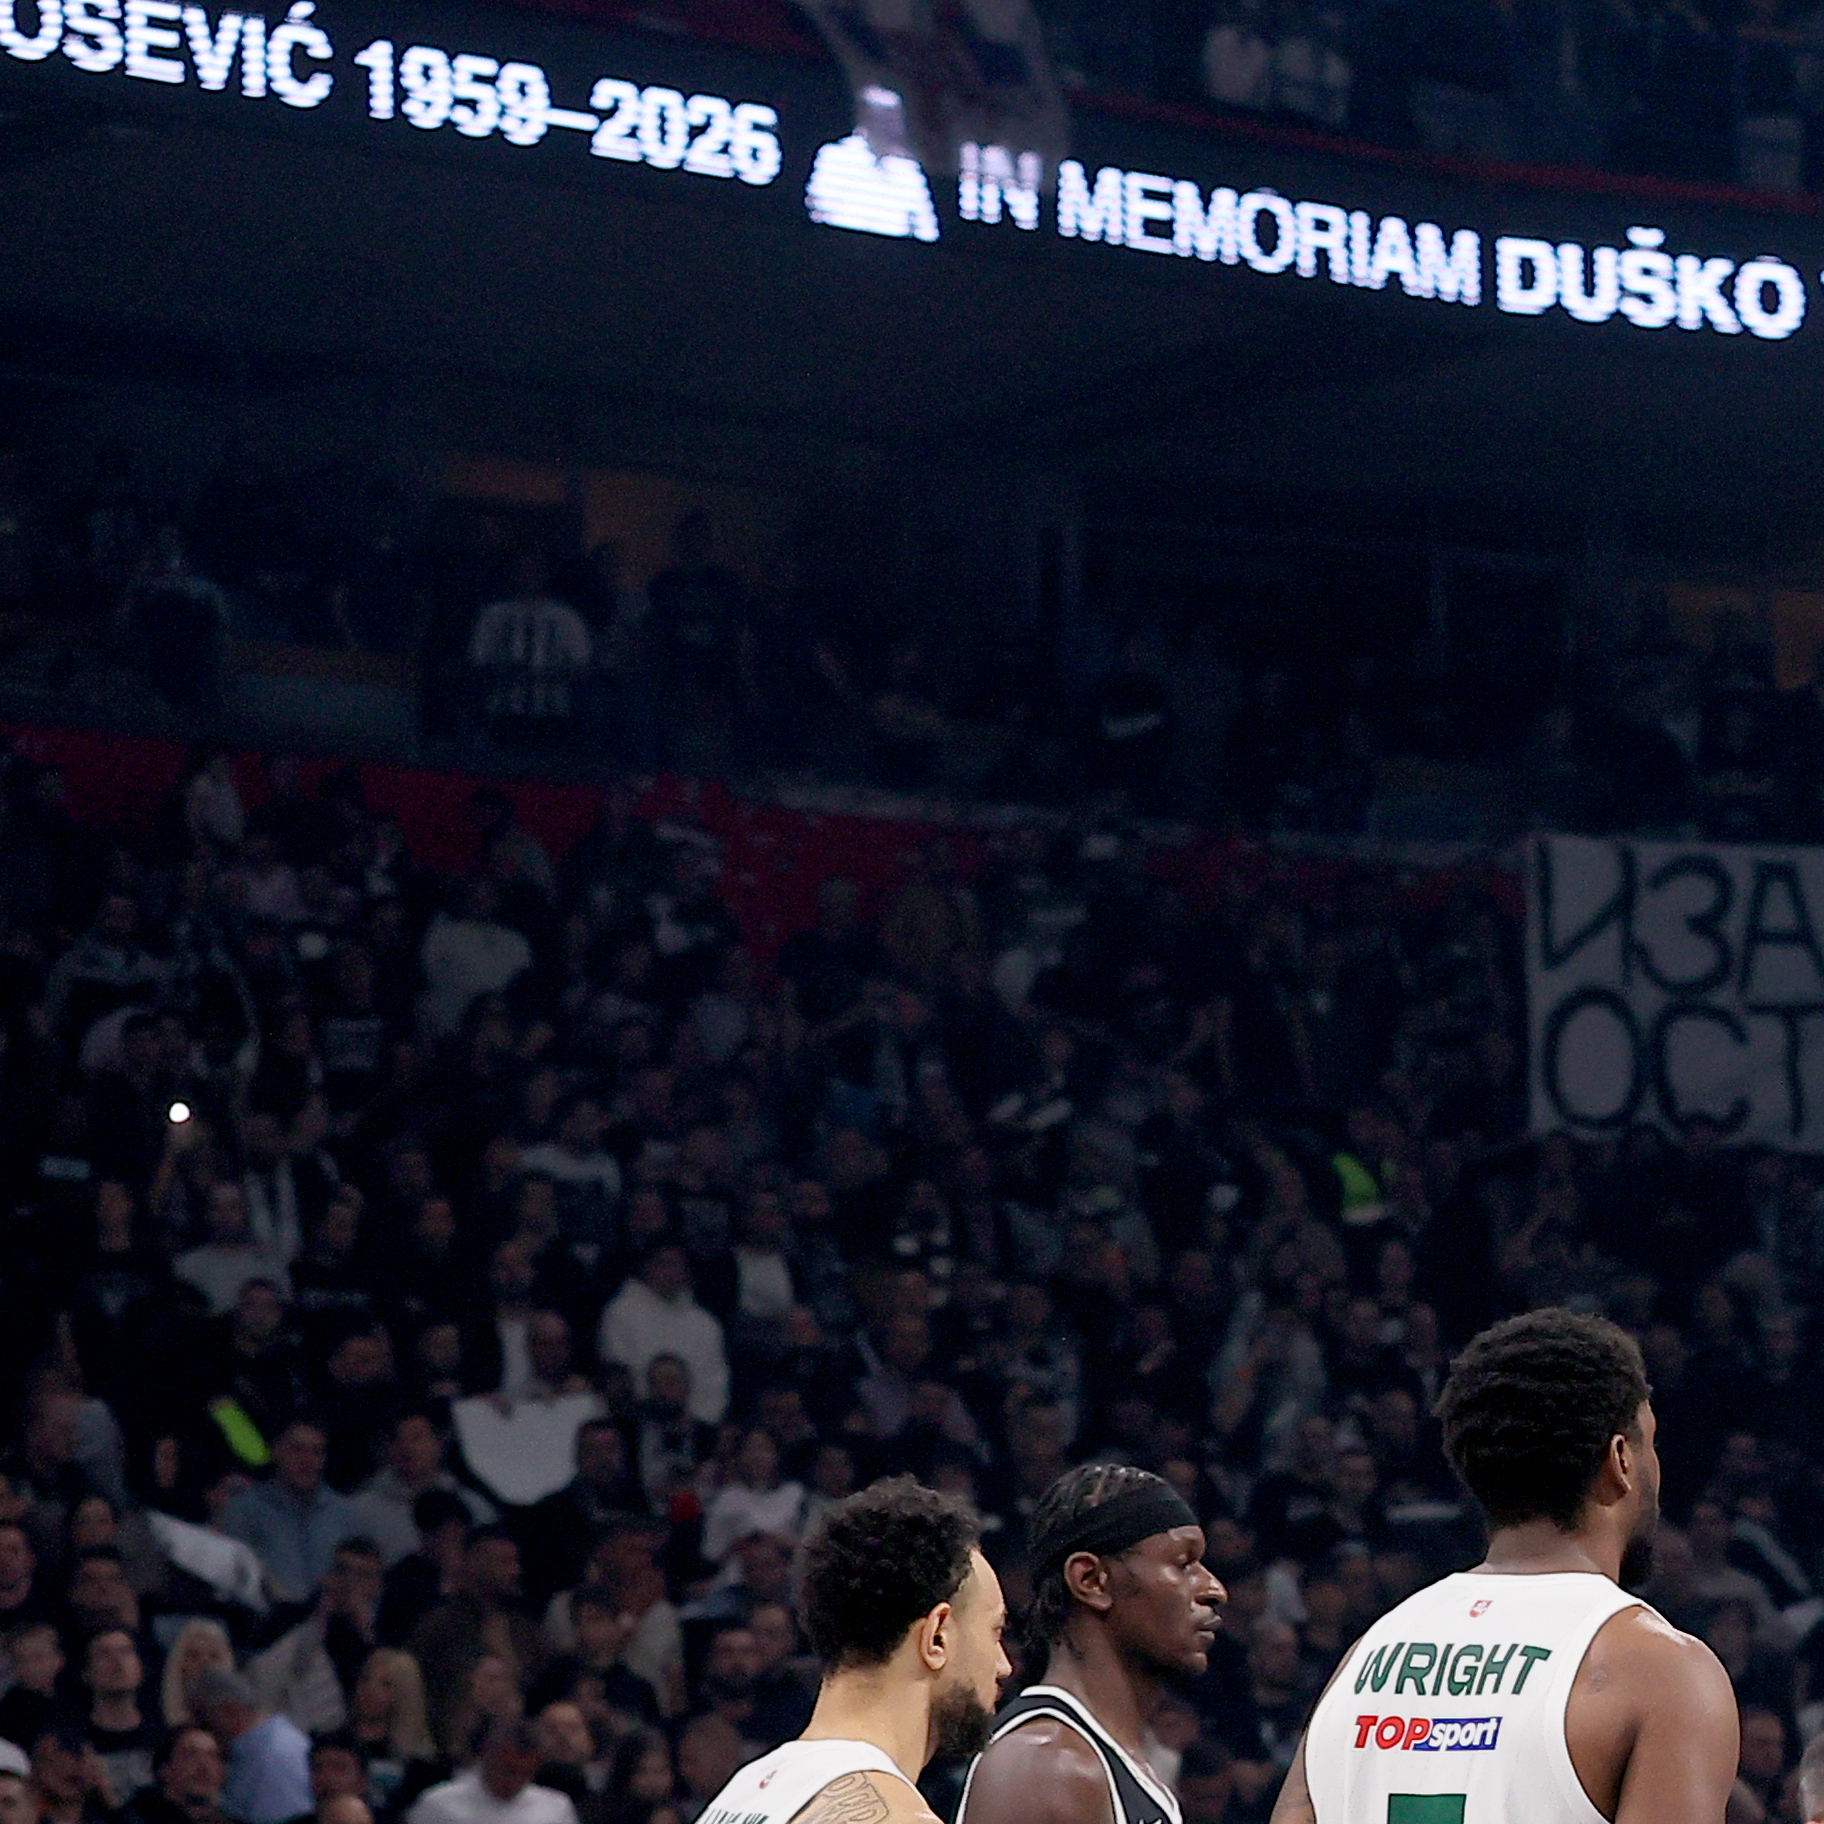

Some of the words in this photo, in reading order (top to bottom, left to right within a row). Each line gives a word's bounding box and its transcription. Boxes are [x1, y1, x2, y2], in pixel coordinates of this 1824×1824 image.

[957, 141, 1042, 231] IN
[1057, 158, 1482, 307] MEMORIAM
[1494, 226, 1805, 340] DUŠKO
[1353, 1641, 1553, 1697] WRIGHT
[1353, 1715, 1501, 1752] TOPsport
